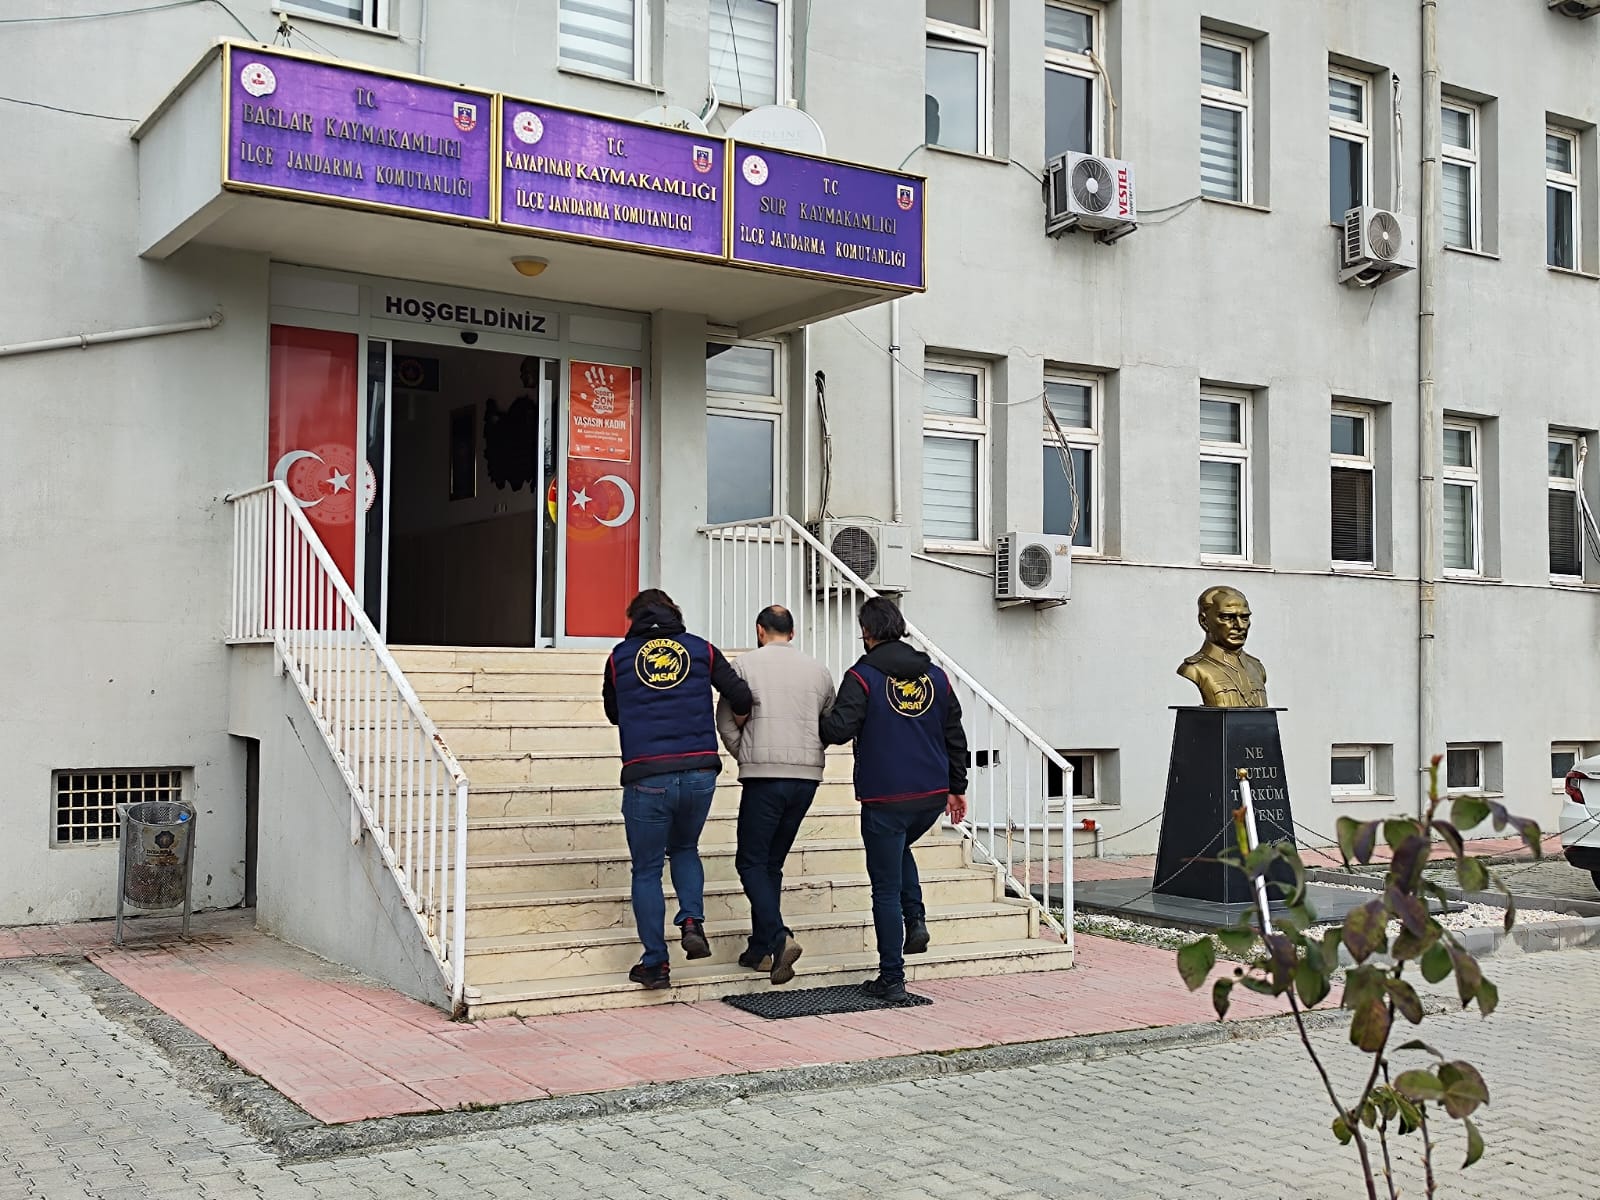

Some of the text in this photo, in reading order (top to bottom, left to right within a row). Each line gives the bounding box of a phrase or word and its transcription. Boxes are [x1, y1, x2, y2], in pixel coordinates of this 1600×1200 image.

[607, 137, 628, 158] T.C.
[240, 139, 274, 167] İLÇE
[287, 150, 365, 180] JANDARMA
[505, 150, 718, 202] KAYAPINAR KAYMAKAMLIĞI
[1118, 168, 1127, 215] VESTEL
[516, 188, 545, 212] İLÇE
[548, 196, 610, 220] JANDARMA
[760, 195, 787, 216] SUR
[740, 223, 765, 246] İLÇE
[770, 230, 825, 255] JANDARMA
[385, 295, 546, 334] HOŞGELDİNİZ
[594, 396, 613, 405] SON
[574, 417, 625, 429] YAŞASIN KADIN
[640, 639, 686, 657] JANDARMA
[649, 672, 678, 683] JASAT
[899, 701, 923, 710] JASAT
[1245, 747, 1264, 759] NE
[1231, 785, 1284, 801] TRKÜM
